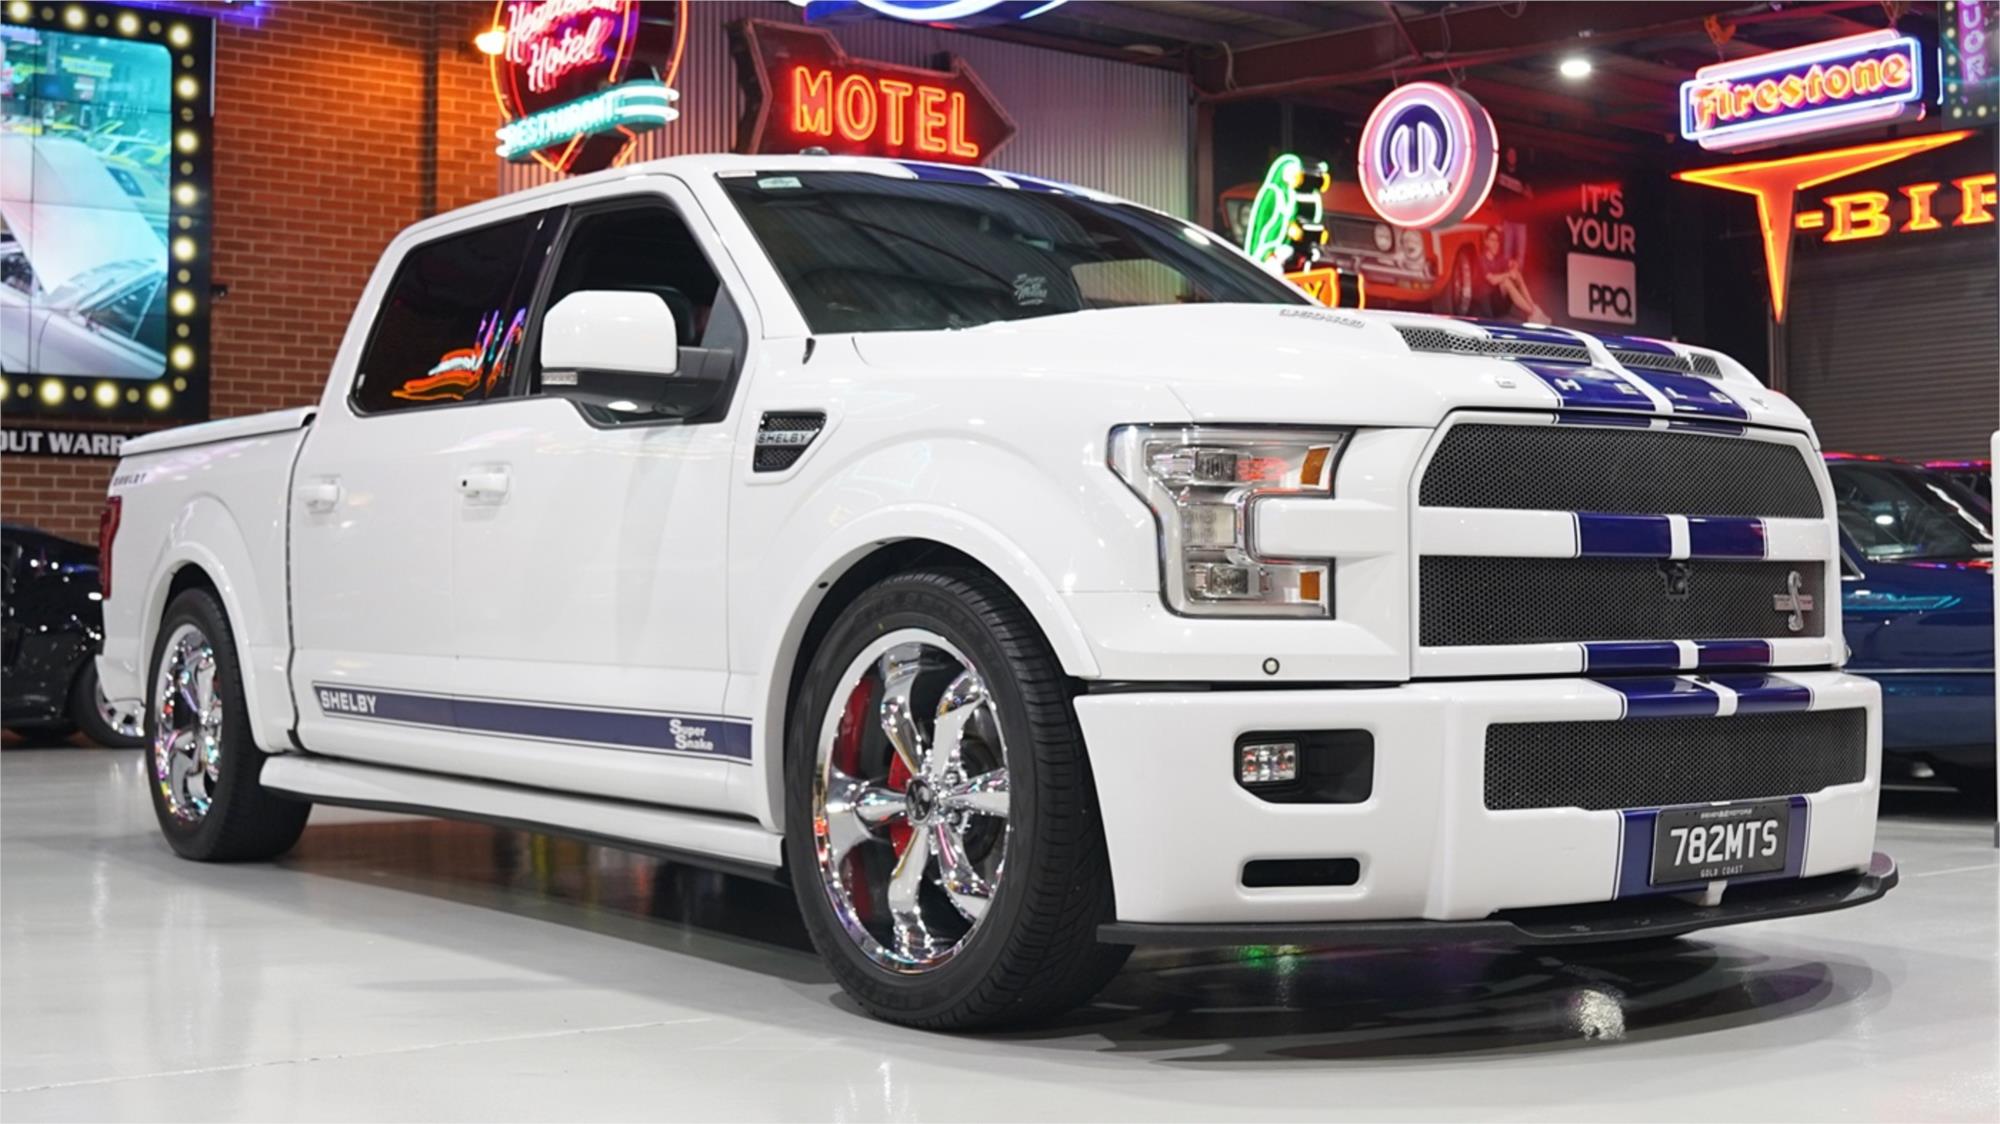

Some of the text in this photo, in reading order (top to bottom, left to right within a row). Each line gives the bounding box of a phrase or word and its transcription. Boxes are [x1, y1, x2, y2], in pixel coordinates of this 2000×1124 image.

[527, 16, 602, 91] Hotel
[1960, 1, 1985, 83] UOR
[1688, 53, 1912, 131] Firestone
[794, 66, 979, 158] MOTEL
[1378, 178, 1450, 203] MOPAR
[1581, 183, 1624, 219] IT'S
[1566, 215, 1636, 254] YOUR
[1588, 282, 1632, 318] PPQ
[48, 432, 136, 455] WARR
[758, 432, 807, 444] SHELBY
[320, 689, 377, 714] SHELBY
[669, 718, 706, 738] Super
[675, 734, 714, 751] Snake
[1670, 819, 1778, 866] 782MTS
[1700, 865, 1743, 878] GOLD COAST
